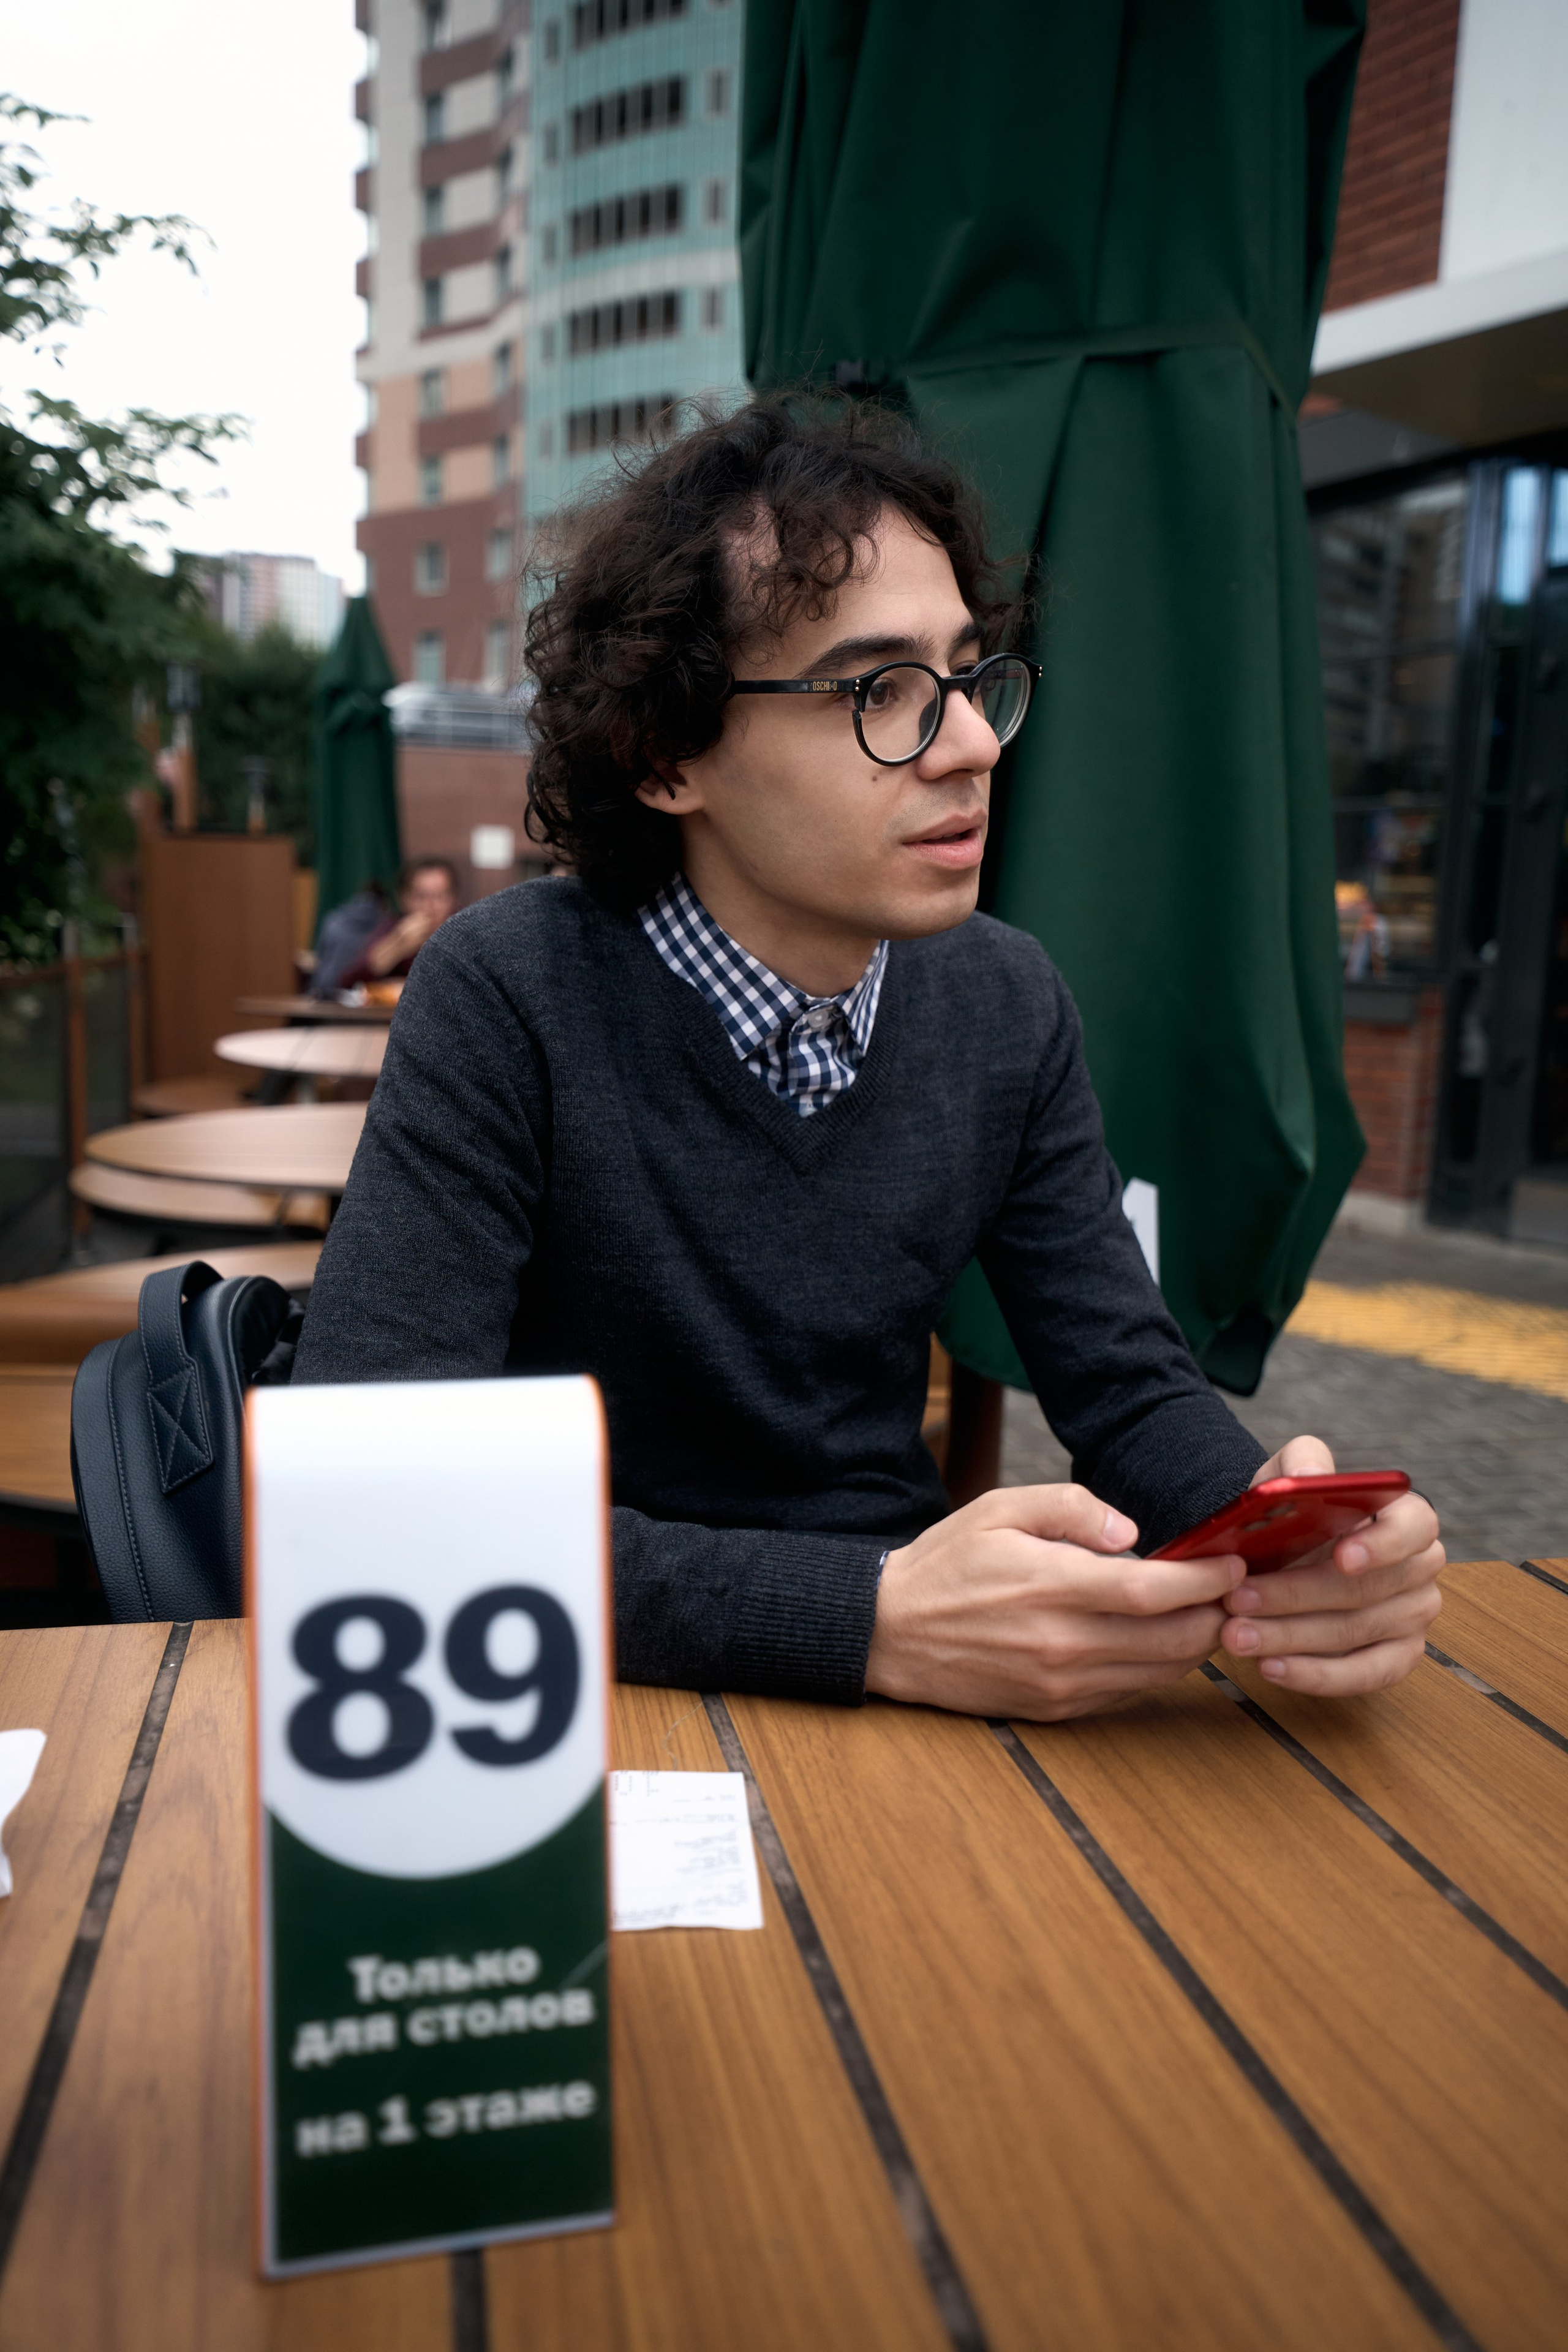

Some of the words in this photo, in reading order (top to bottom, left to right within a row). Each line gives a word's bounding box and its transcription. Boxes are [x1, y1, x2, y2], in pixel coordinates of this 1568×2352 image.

[284, 1584, 581, 1784] 89
[350, 1947, 540, 2002] Только
[293, 2013, 397, 2068] для
[407, 1988, 595, 2045] столов
[297, 2112, 367, 2155] на
[380, 2096, 415, 2143] 1
[427, 2081, 595, 2136] этаже
